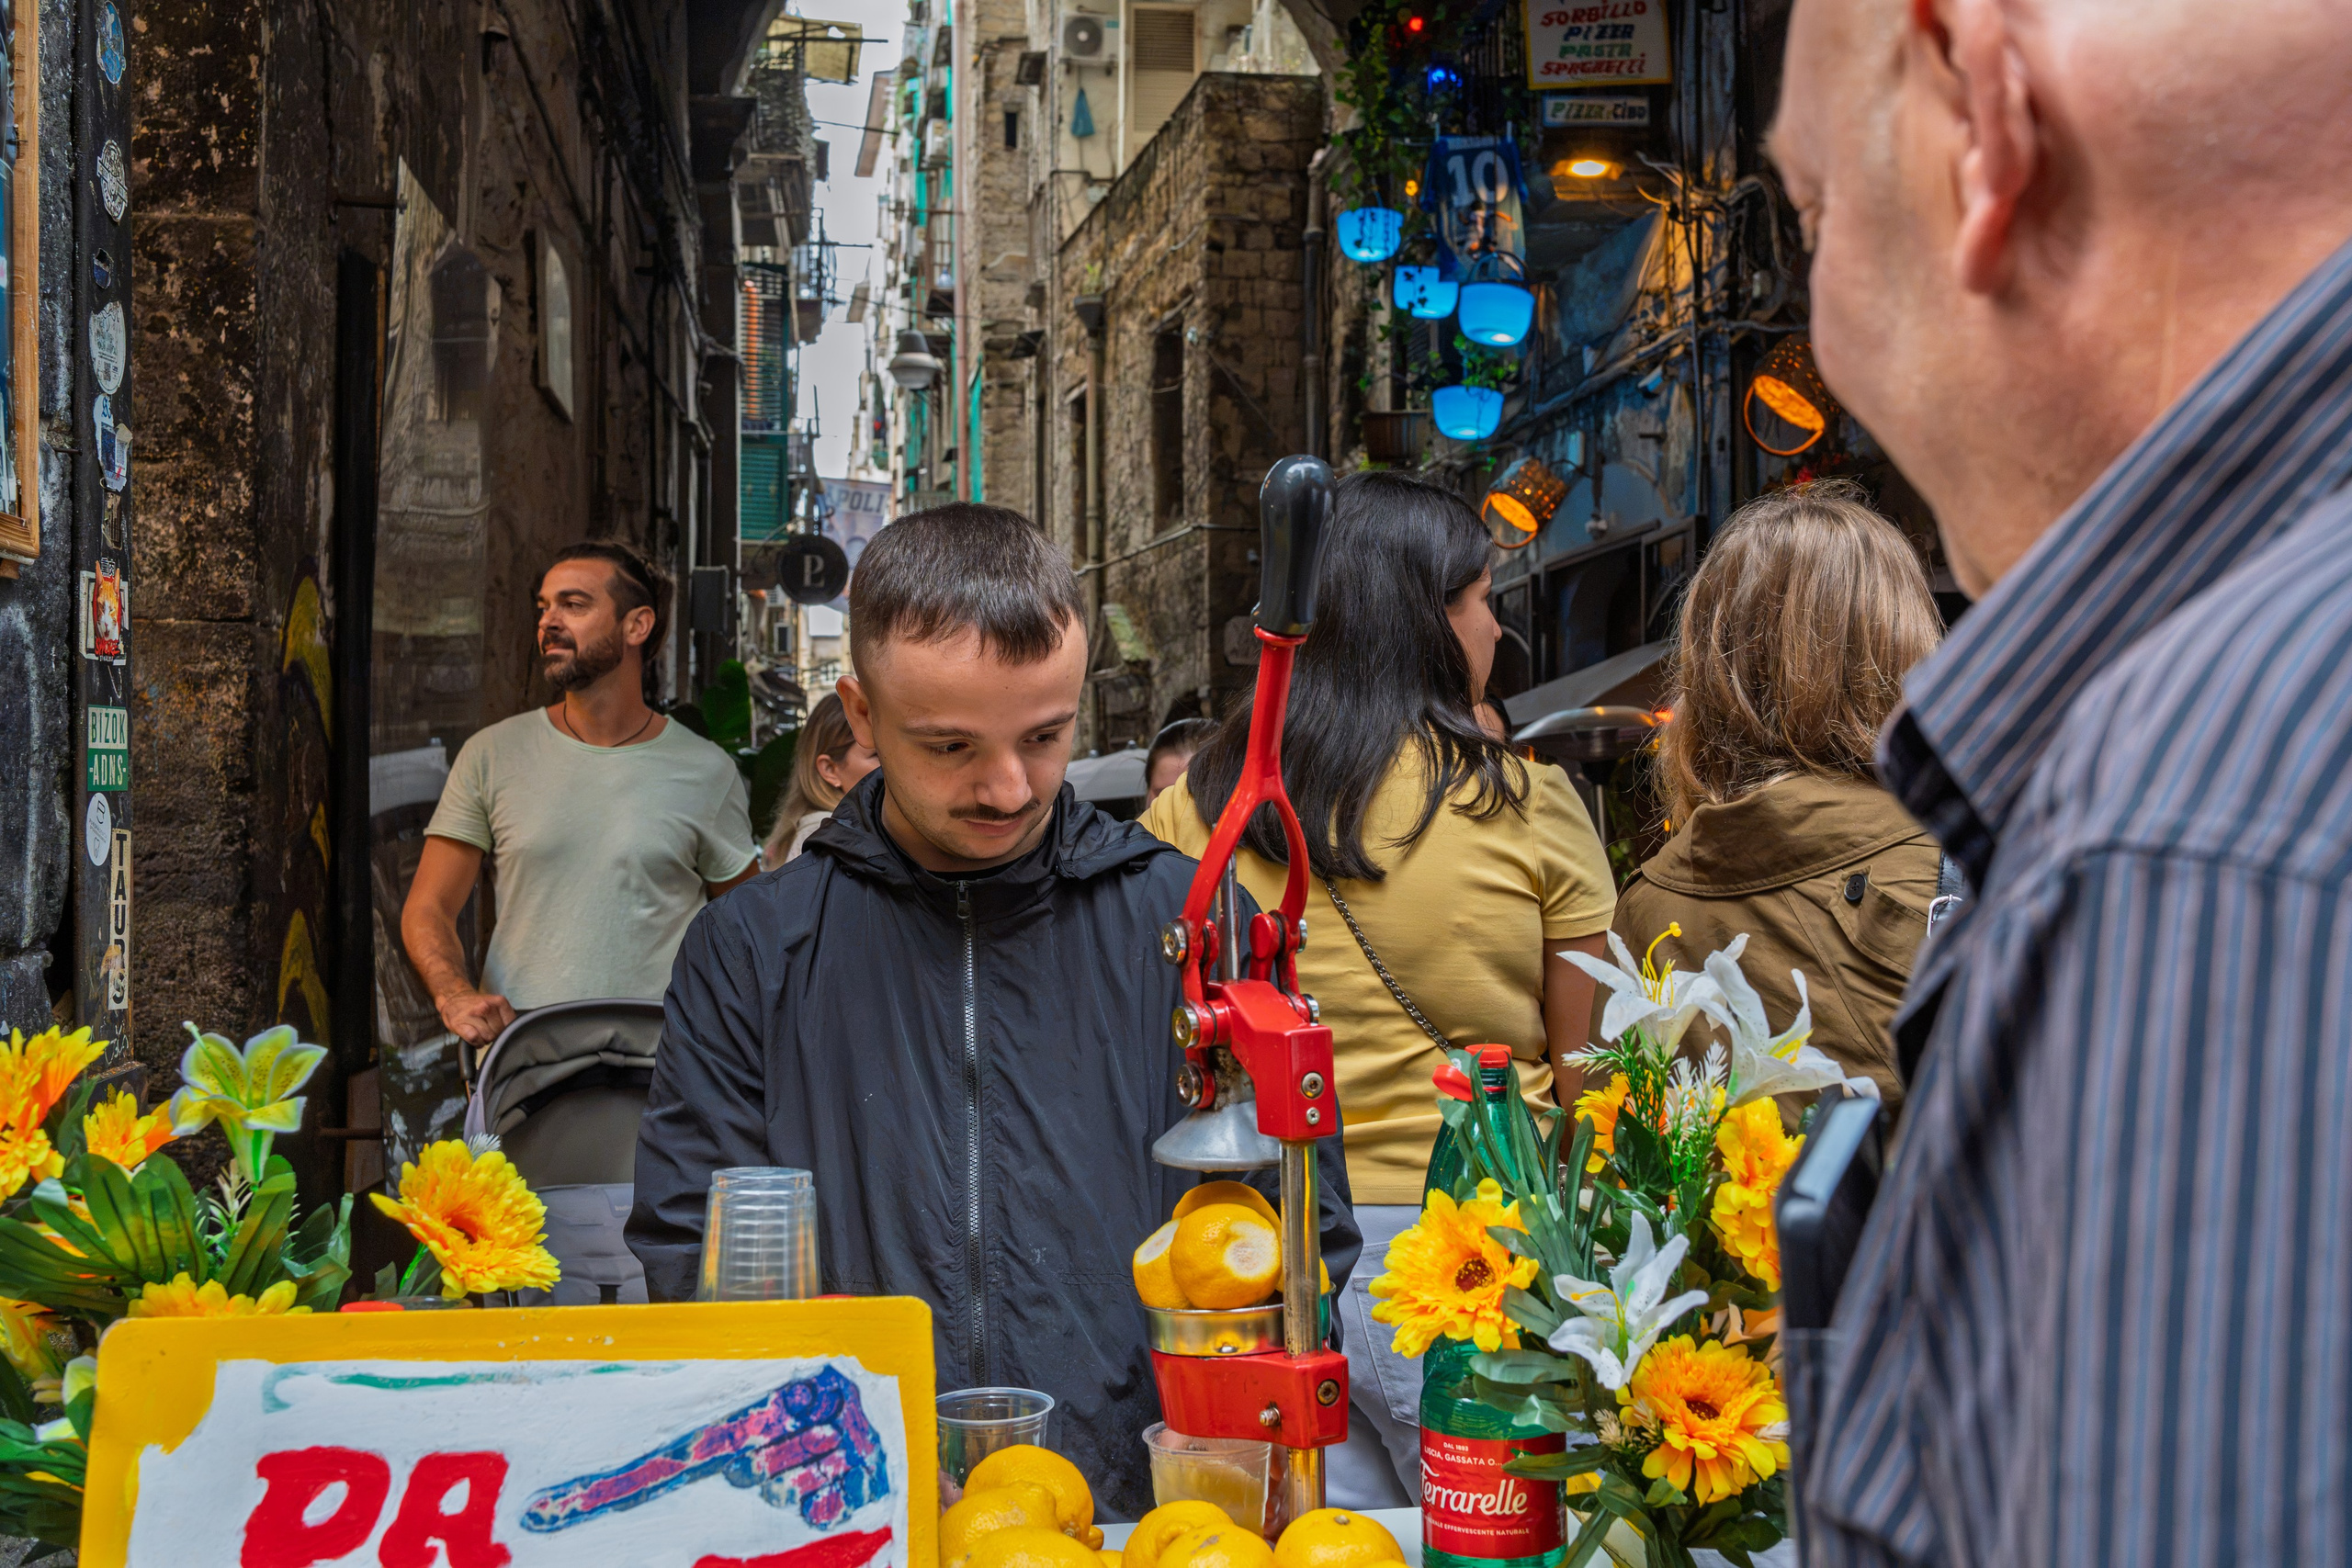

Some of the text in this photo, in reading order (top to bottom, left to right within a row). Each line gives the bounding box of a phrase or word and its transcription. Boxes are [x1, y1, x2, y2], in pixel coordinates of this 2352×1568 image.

[1447, 151, 1509, 207] 10
[1420, 1457, 1528, 1516] Ferrarelle
[1444, 1453, 1486, 1466] GASSATA
[241, 1446, 512, 1568] DA
[1444, 1524, 1495, 1536] EFFERVESCENTE
